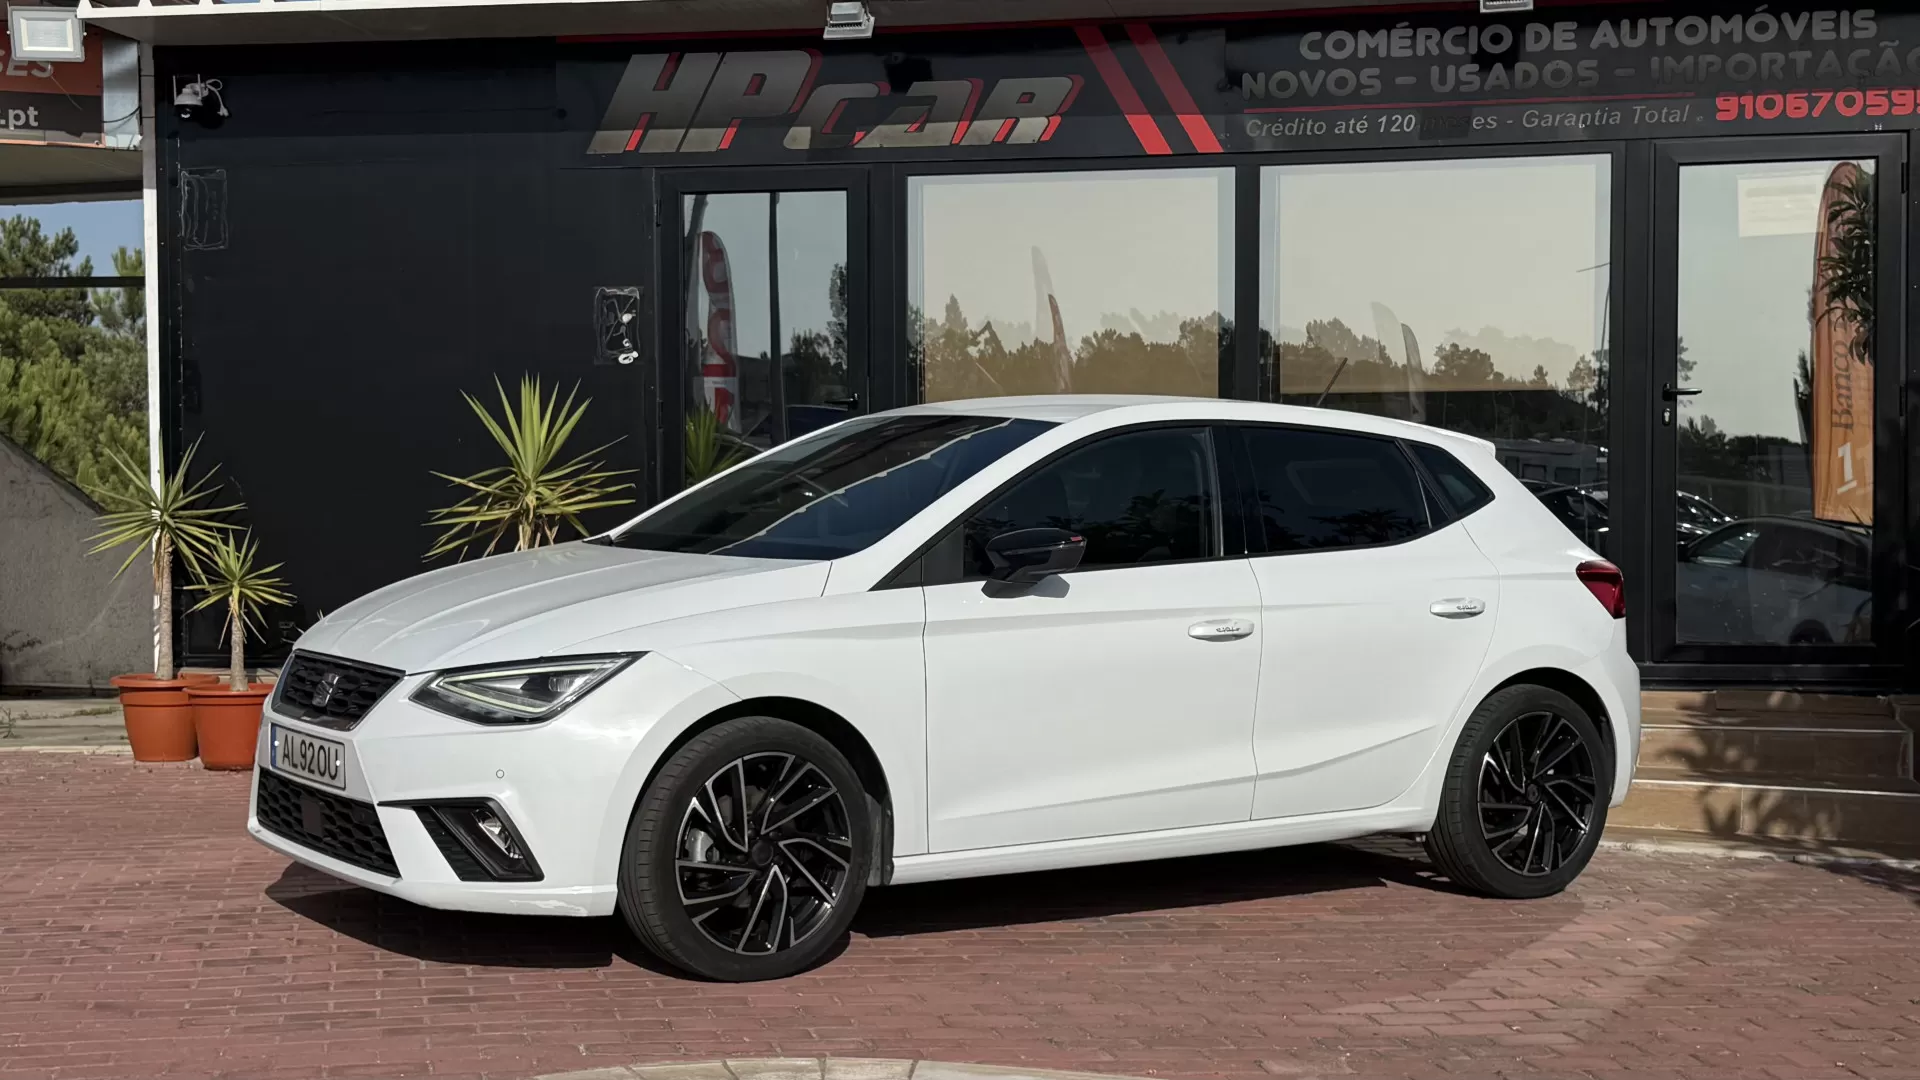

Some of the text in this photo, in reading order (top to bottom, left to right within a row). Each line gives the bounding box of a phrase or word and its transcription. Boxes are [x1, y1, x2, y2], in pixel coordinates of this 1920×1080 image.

[1300, 4, 1878, 60] COMÉRCIO DE AUTOMÓVEIS
[1242, 68, 1381, 99] NOVOS
[1430, 60, 1600, 93] USADOS
[0, 106, 39, 131] .pt
[1245, 117, 1327, 137] Crédito
[1334, 115, 1369, 134] até
[1377, 114, 1416, 133] 120
[1522, 107, 1621, 128] Garantia
[1632, 104, 1690, 125] Total
[1715, 88, 1920, 121] 91067059
[1831, 340, 1854, 432] Banco
